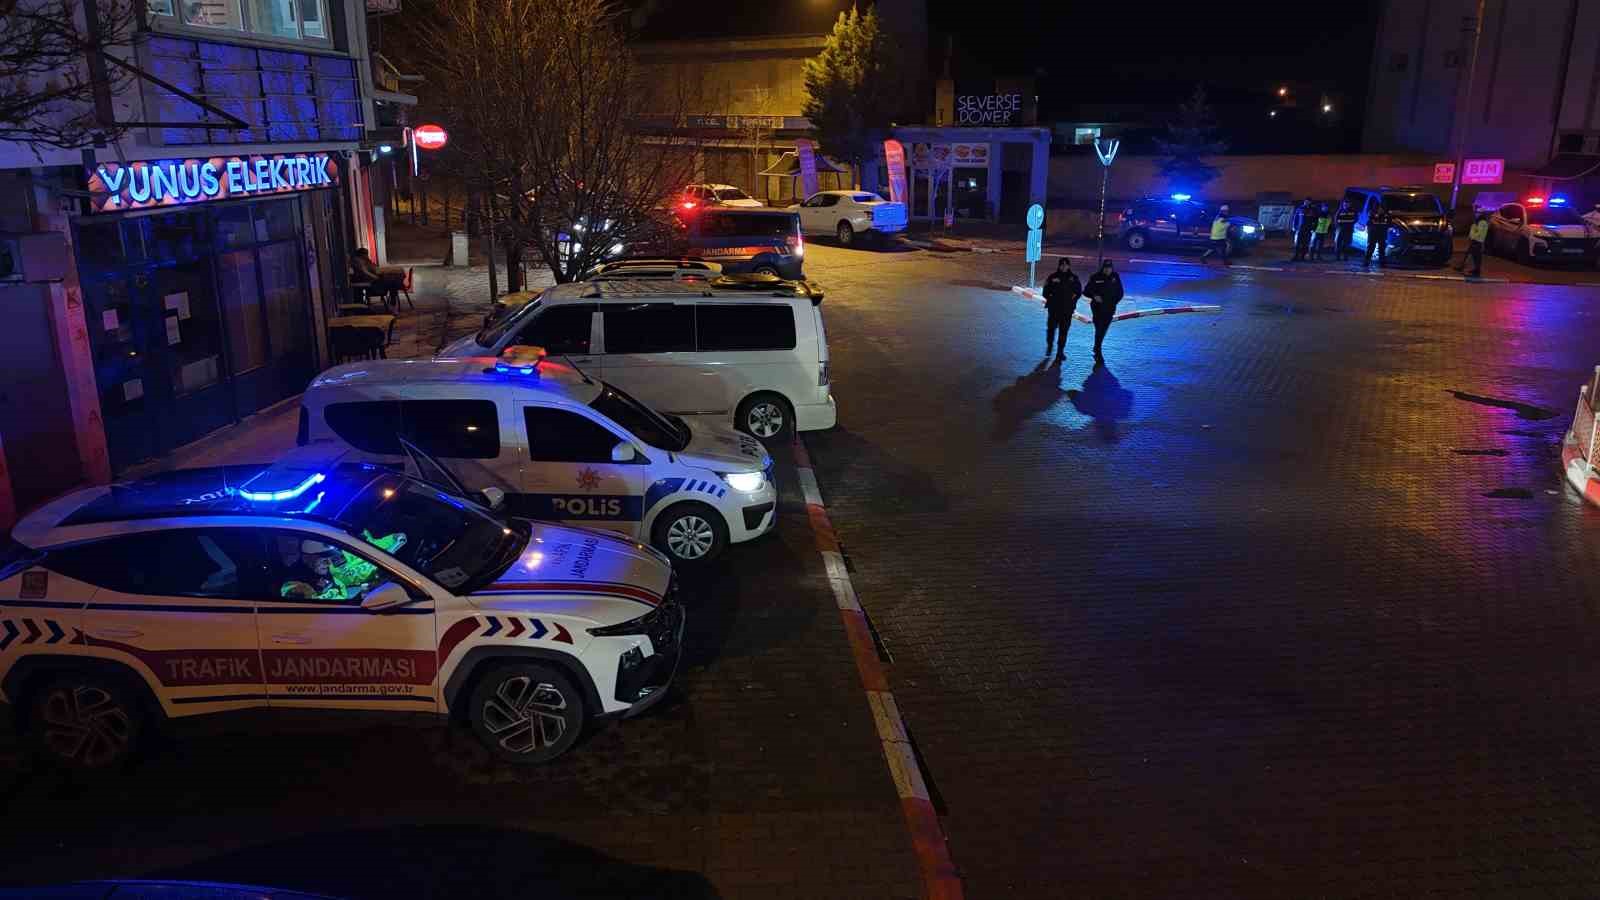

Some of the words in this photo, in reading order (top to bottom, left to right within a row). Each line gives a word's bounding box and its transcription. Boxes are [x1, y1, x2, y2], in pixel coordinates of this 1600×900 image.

[958, 94, 1020, 111] SEVERSE
[98, 163, 219, 205] YUNUS
[227, 157, 332, 193] ELEKTRİK
[704, 248, 746, 256] JANDARMA
[551, 498, 621, 516] POLİS
[166, 658, 253, 679] TRAFİK
[270, 657, 417, 679] JANDARMASI
[285, 683, 415, 697] www.jandarma.gov.tr
